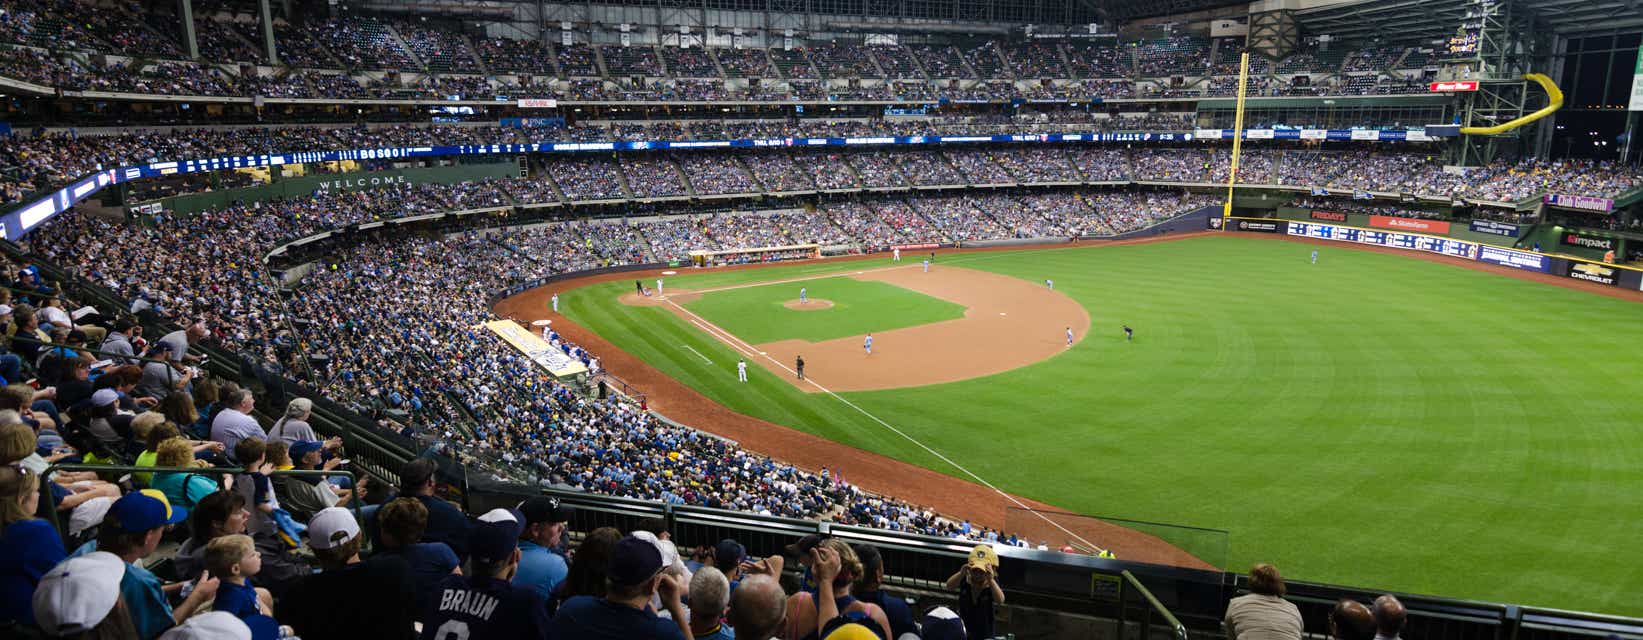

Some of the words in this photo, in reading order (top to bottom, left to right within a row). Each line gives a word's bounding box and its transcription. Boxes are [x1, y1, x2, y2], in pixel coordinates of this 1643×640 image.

[319, 175, 405, 190] WELCOME
[1558, 194, 1573, 208] Club
[1575, 196, 1608, 211] Goodwill
[1575, 234, 1612, 249] impact
[1571, 271, 1614, 285] CHEVROLET
[439, 588, 500, 621] BRAUN
